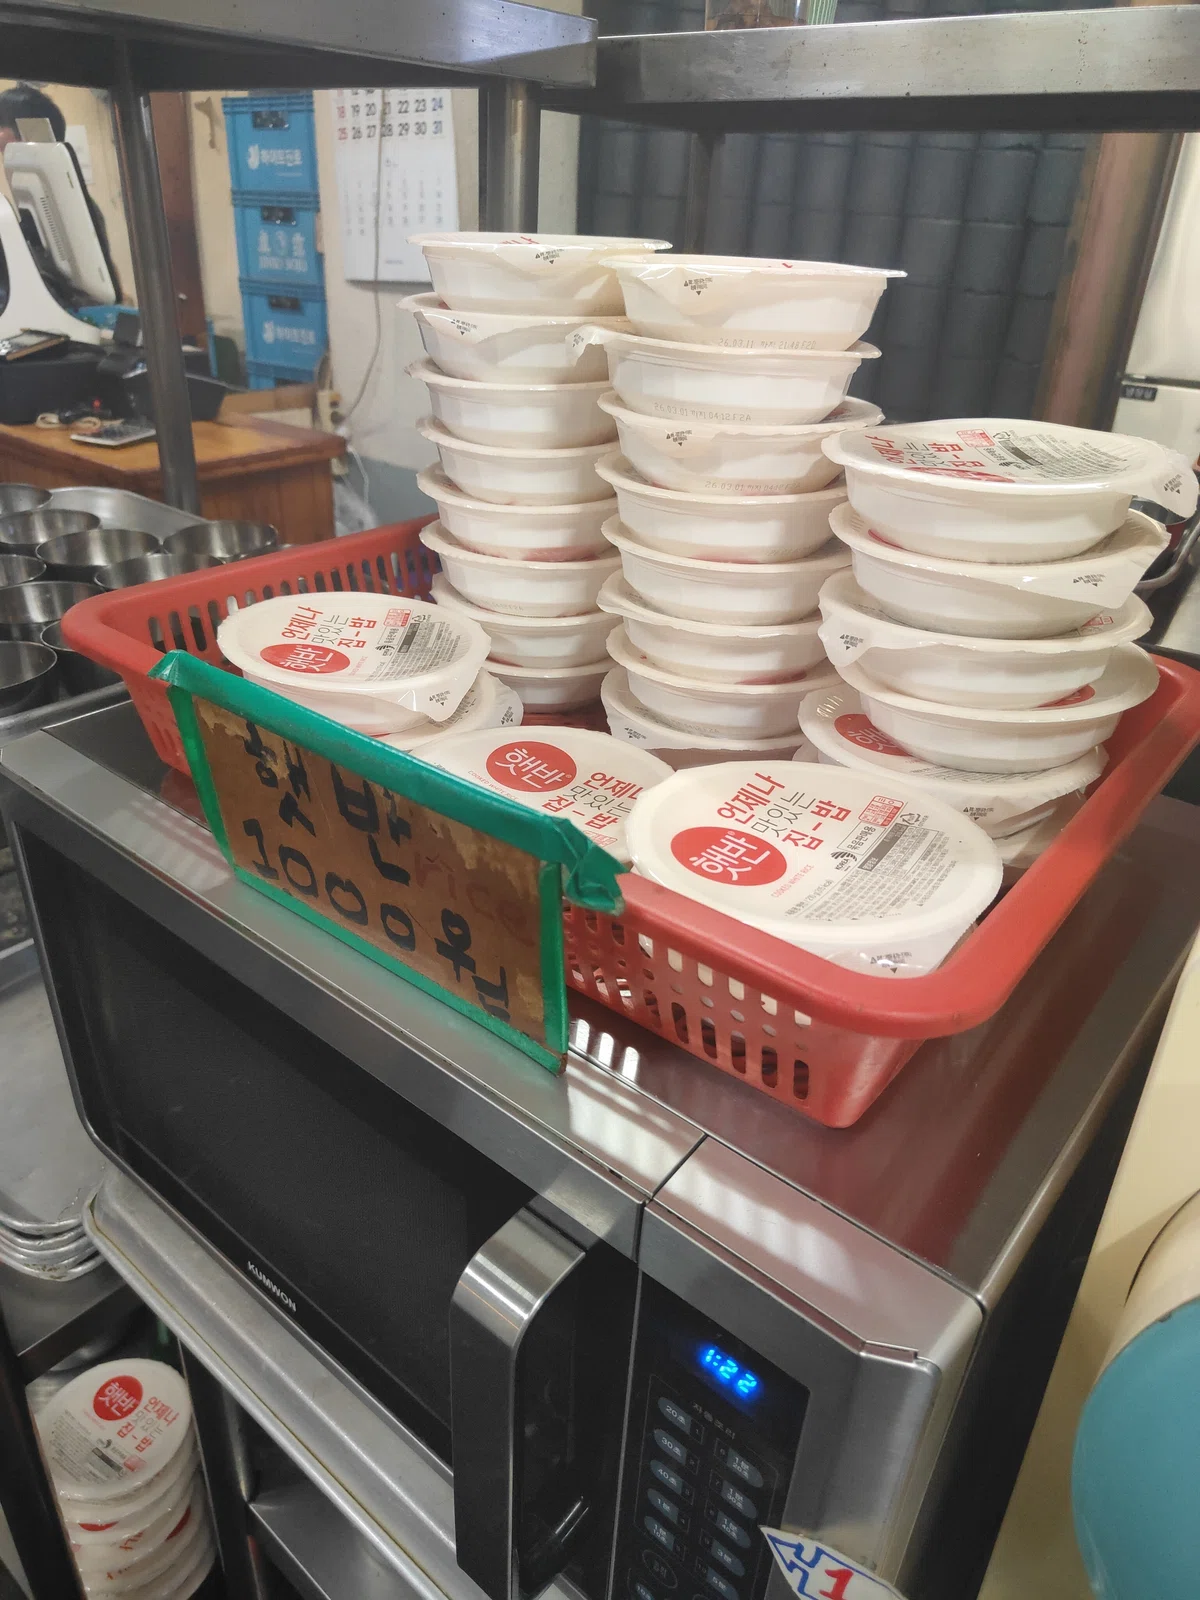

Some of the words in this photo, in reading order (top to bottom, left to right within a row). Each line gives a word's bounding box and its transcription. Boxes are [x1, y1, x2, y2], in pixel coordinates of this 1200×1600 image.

[351, 104, 360, 117] 19
[366, 103, 377, 117] 20
[398, 100, 410, 114] 22
[415, 98, 427, 113] 23
[432, 97, 444, 112] 24
[338, 127, 349, 141] 25
[352, 126, 363, 140] 26
[367, 125, 377, 138] 27
[381, 123, 393, 137] 28
[398, 122, 410, 137] 29
[415, 121, 427, 135] 30
[433, 120, 443, 135] 31
[281, 606, 323, 641] 언제나
[311, 614, 349, 645] 맛있는
[279, 645, 334, 673] 햇반
[467, 770, 490, 787] COOKED
[489, 782, 506, 796] WHITE
[495, 748, 567, 790] 햇반
[563, 785, 632, 818] 맛있는
[717, 772, 786, 825] 언제나
[751, 792, 816, 838] 맛있는
[689, 834, 771, 881] 햇반
[242, 818, 512, 1020] 1000원
[247, 1260, 297, 1312] KUMWON
[704, 1349, 758, 1393] 1:22
[98, 1381, 137, 1417] 햇반
[143, 1396, 180, 1428] 언제나
[818, 1568, 854, 1600] 1
